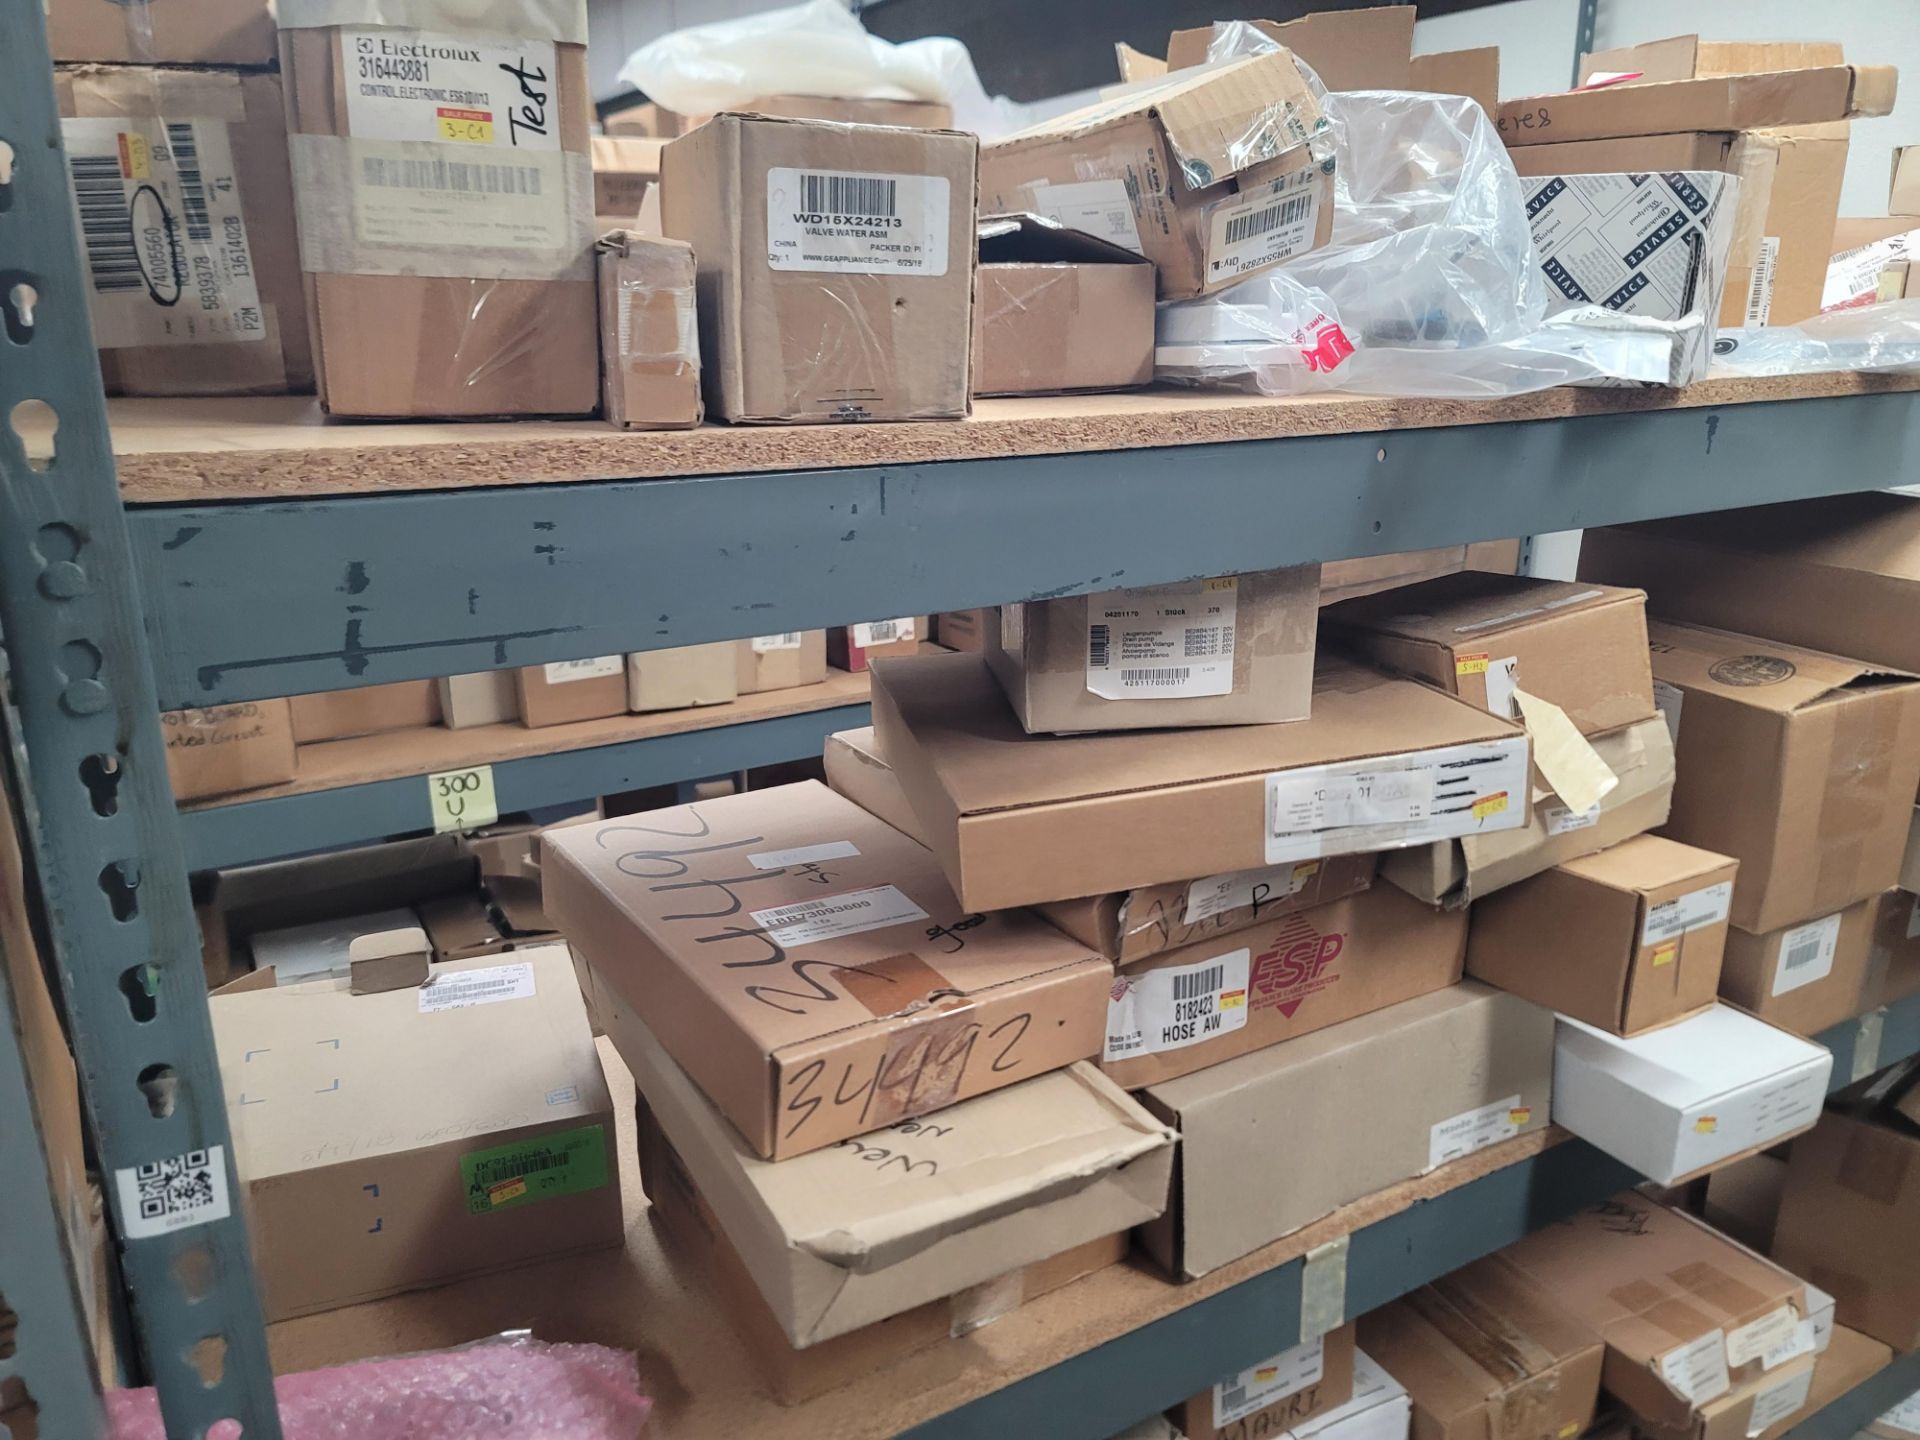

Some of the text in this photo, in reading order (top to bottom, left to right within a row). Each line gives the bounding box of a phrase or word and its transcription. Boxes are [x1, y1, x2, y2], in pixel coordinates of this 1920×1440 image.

[381, 38, 481, 63] Electrolux
[359, 56, 430, 83] 316443881
[499, 57, 548, 146] Test
[1525, 178, 1565, 219] RVICE
[793, 213, 902, 228] WD15X24213
[805, 227, 888, 239] VALVE WATER ASM
[870, 243, 901, 253] PACKER
[1626, 214, 1686, 267] SERVICE
[143, 227, 173, 290] 74005560
[1544, 259, 1583, 301] ERVICE
[1602, 274, 1646, 311] RVICE
[437, 772, 480, 797] 300
[446, 797, 465, 816] U
[1175, 994, 1214, 1022] 8182423
[1162, 1014, 1222, 1043] HOSE AW
